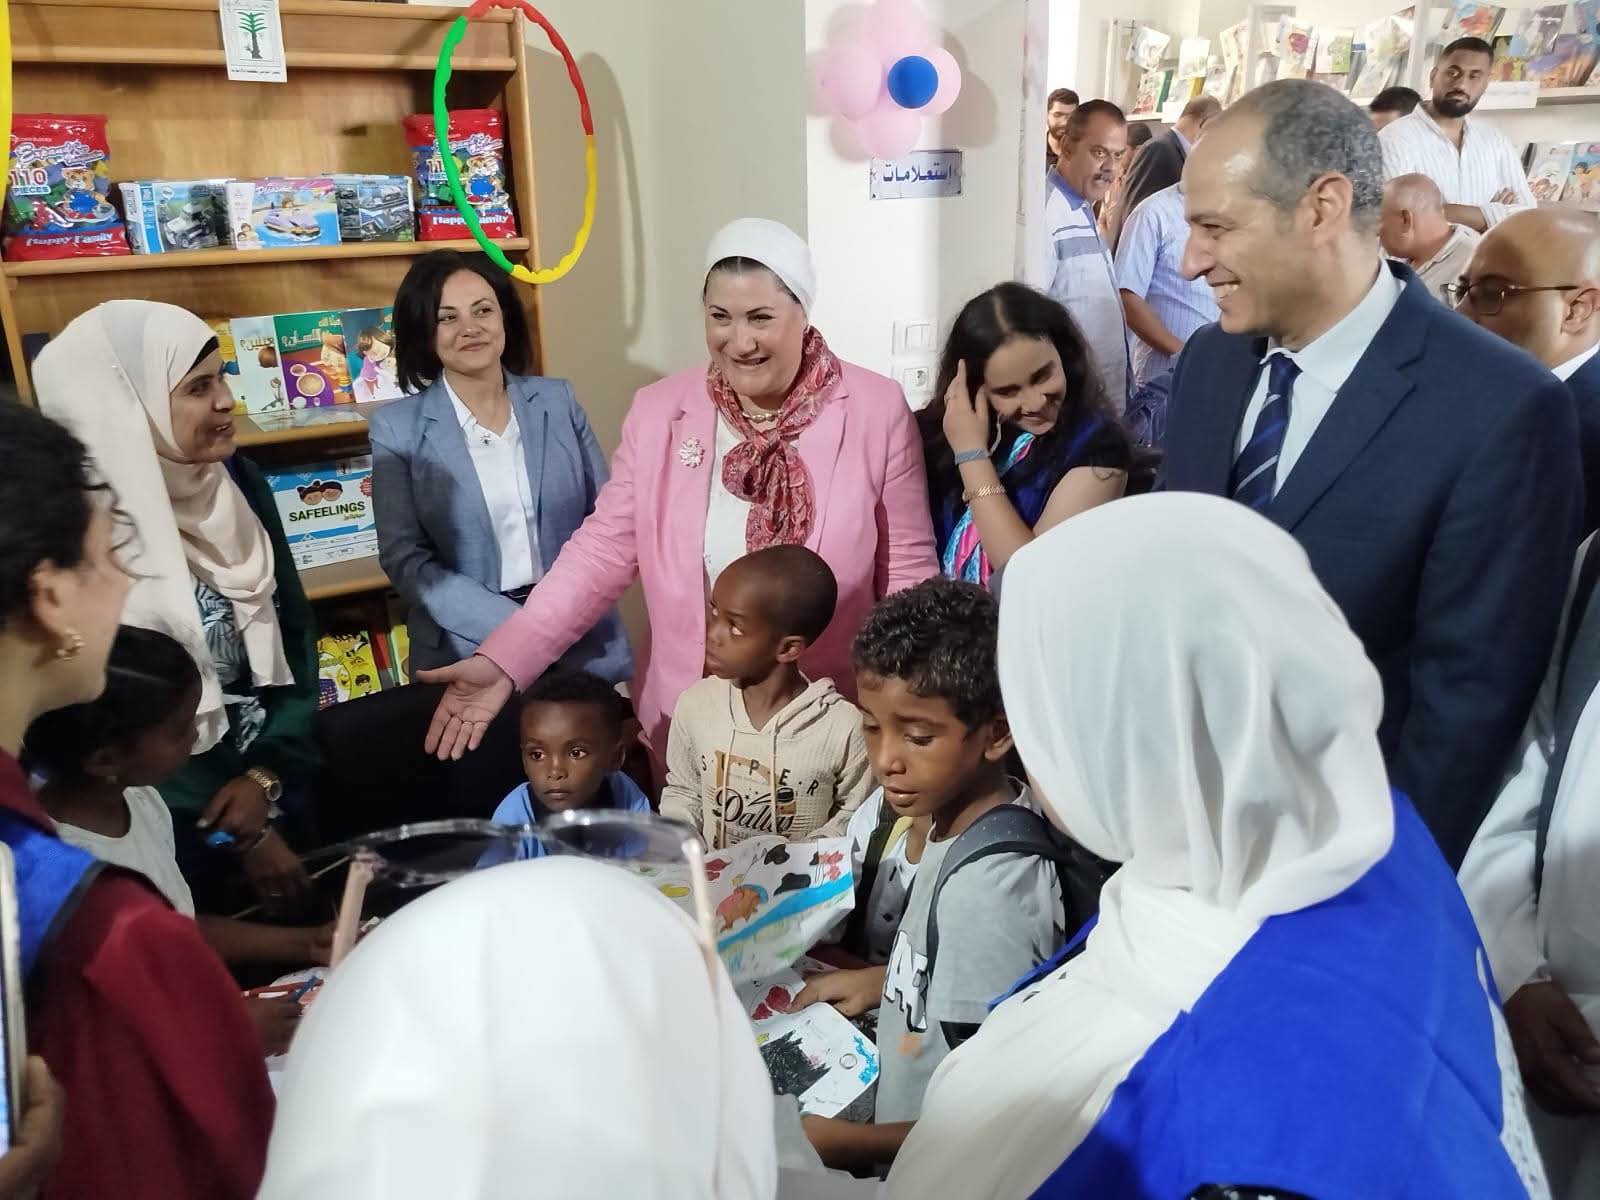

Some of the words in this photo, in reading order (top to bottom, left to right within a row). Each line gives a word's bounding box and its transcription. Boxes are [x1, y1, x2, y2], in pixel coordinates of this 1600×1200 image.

[10, 169, 48, 186] 110
[13, 185, 50, 194] PIECES
[26, 235, 72, 247] Happy
[74, 232, 113, 244] Family
[288, 501, 366, 522] SAFEELINGS
